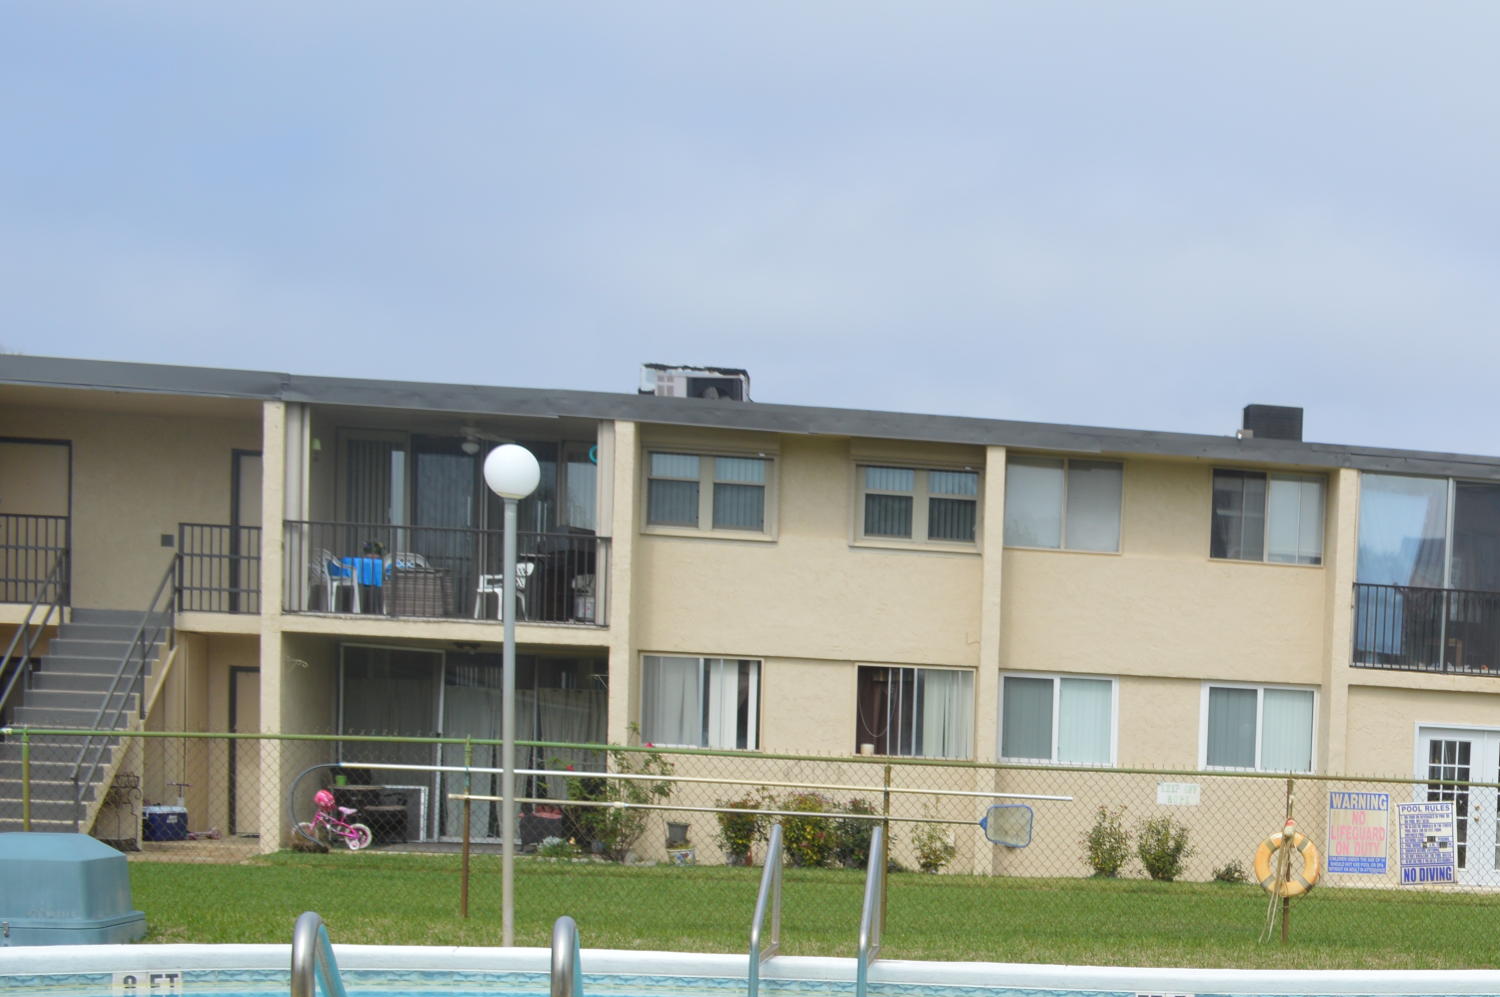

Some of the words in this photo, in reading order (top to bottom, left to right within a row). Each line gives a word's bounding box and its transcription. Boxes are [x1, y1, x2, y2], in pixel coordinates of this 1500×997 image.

[1332, 792, 1387, 810] WARNING
[1424, 804, 1450, 812] RULES
[1351, 811, 1366, 825] NO
[1330, 824, 1386, 841] LIFEGUARD
[1335, 841, 1350, 856] ON
[1354, 841, 1380, 856] DUTY
[1403, 867, 1417, 883] NO
[1419, 866, 1452, 882] DIVING
[149, 973, 179, 989] FT
